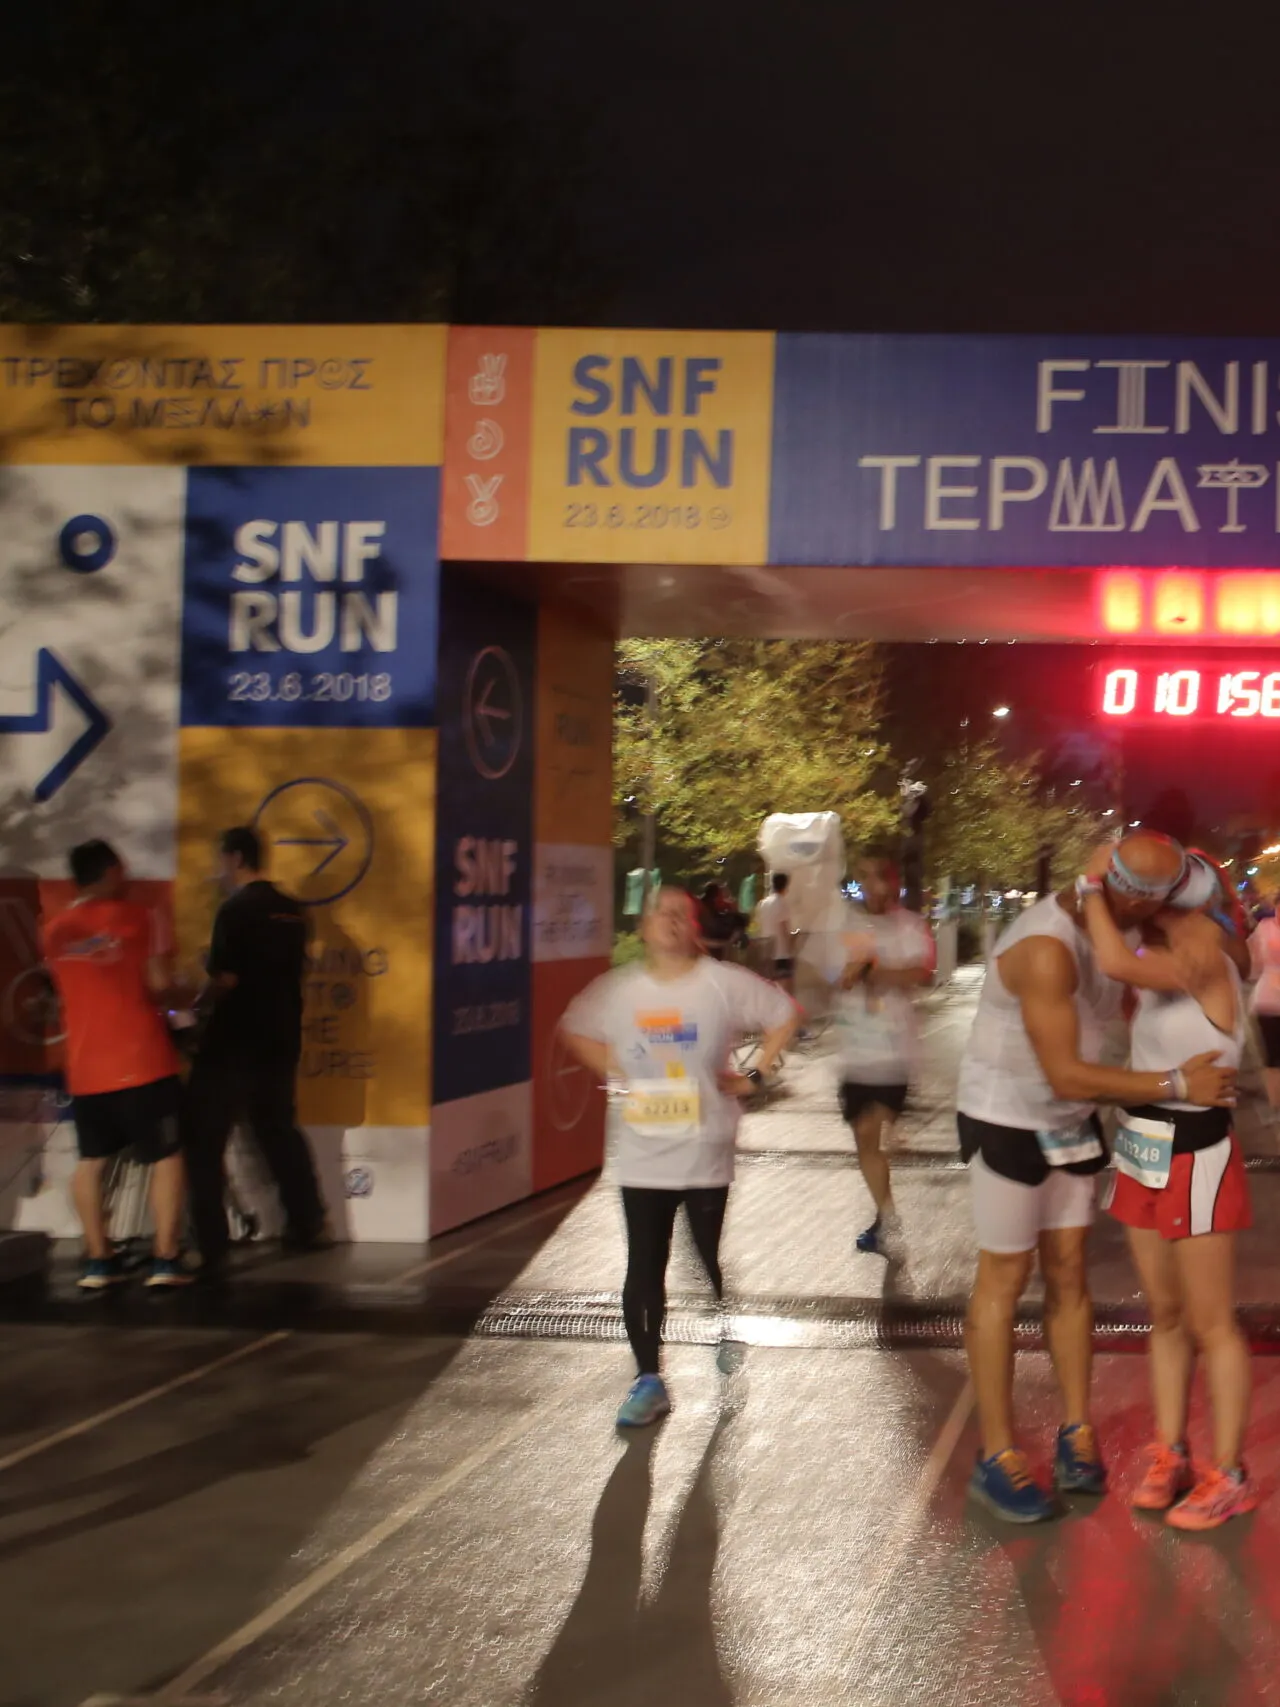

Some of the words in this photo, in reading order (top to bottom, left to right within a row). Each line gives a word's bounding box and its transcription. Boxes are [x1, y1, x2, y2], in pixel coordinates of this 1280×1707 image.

[570, 354, 723, 417] SNF
[566, 427, 734, 489] RUN
[231, 519, 387, 583] SNF
[228, 590, 398, 654] RUN
[228, 672, 392, 702] 23.6.2018
[453, 836, 517, 898] SNF
[451, 904, 523, 964] RUN
